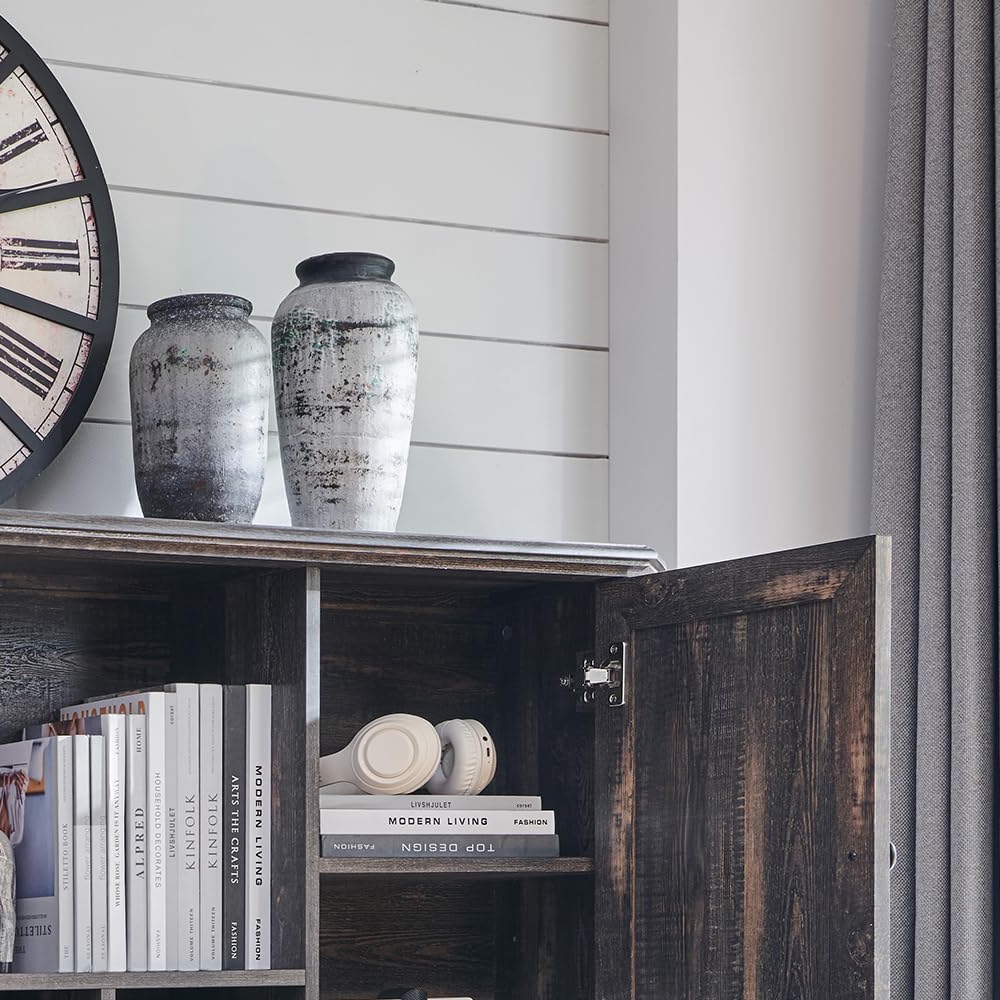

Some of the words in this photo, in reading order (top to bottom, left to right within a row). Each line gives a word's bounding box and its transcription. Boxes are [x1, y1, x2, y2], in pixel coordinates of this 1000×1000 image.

[0, 237, 82, 276] III
[231, 775, 239, 806] ARTS
[255, 766, 263, 828] MODERN
[411, 801, 452, 809] LIVSHJULET
[185, 794, 196, 870] KINFOLK
[208, 793, 218, 869] KINFOLK
[231, 809, 239, 833] THE
[388, 817, 441, 826] MODERN
[447, 817, 489, 826] LIVING
[135, 807, 144, 880] ALPRED
[231, 838, 239, 885] CRAFTS
[255, 836, 263, 886] LIVING
[401, 842, 458, 852] DESIGN
[465, 843, 495, 852] TOP
